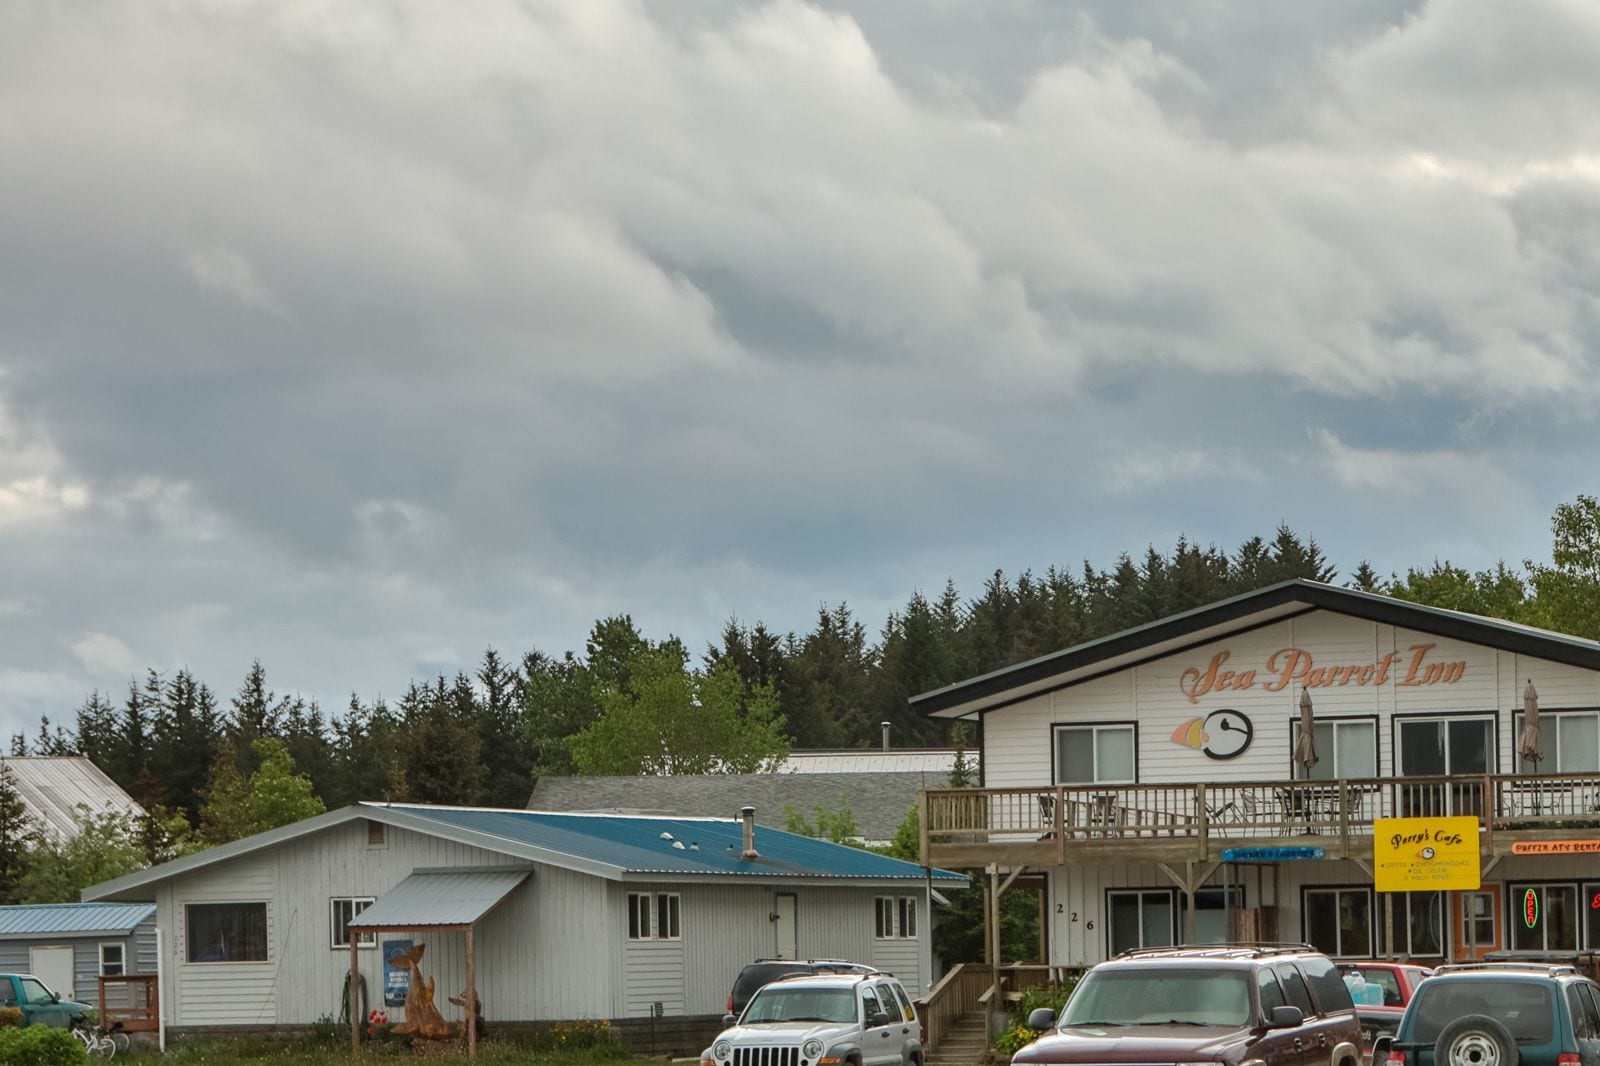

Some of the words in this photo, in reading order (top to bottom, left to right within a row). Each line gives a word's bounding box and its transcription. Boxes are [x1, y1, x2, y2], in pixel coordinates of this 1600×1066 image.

[1180, 650, 1256, 704] Sea
[1263, 648, 1402, 692] Parrot
[1395, 642, 1466, 687] Inn
[1515, 844, 1548, 852] PUFFIN
[1552, 844, 1570, 852] ATV
